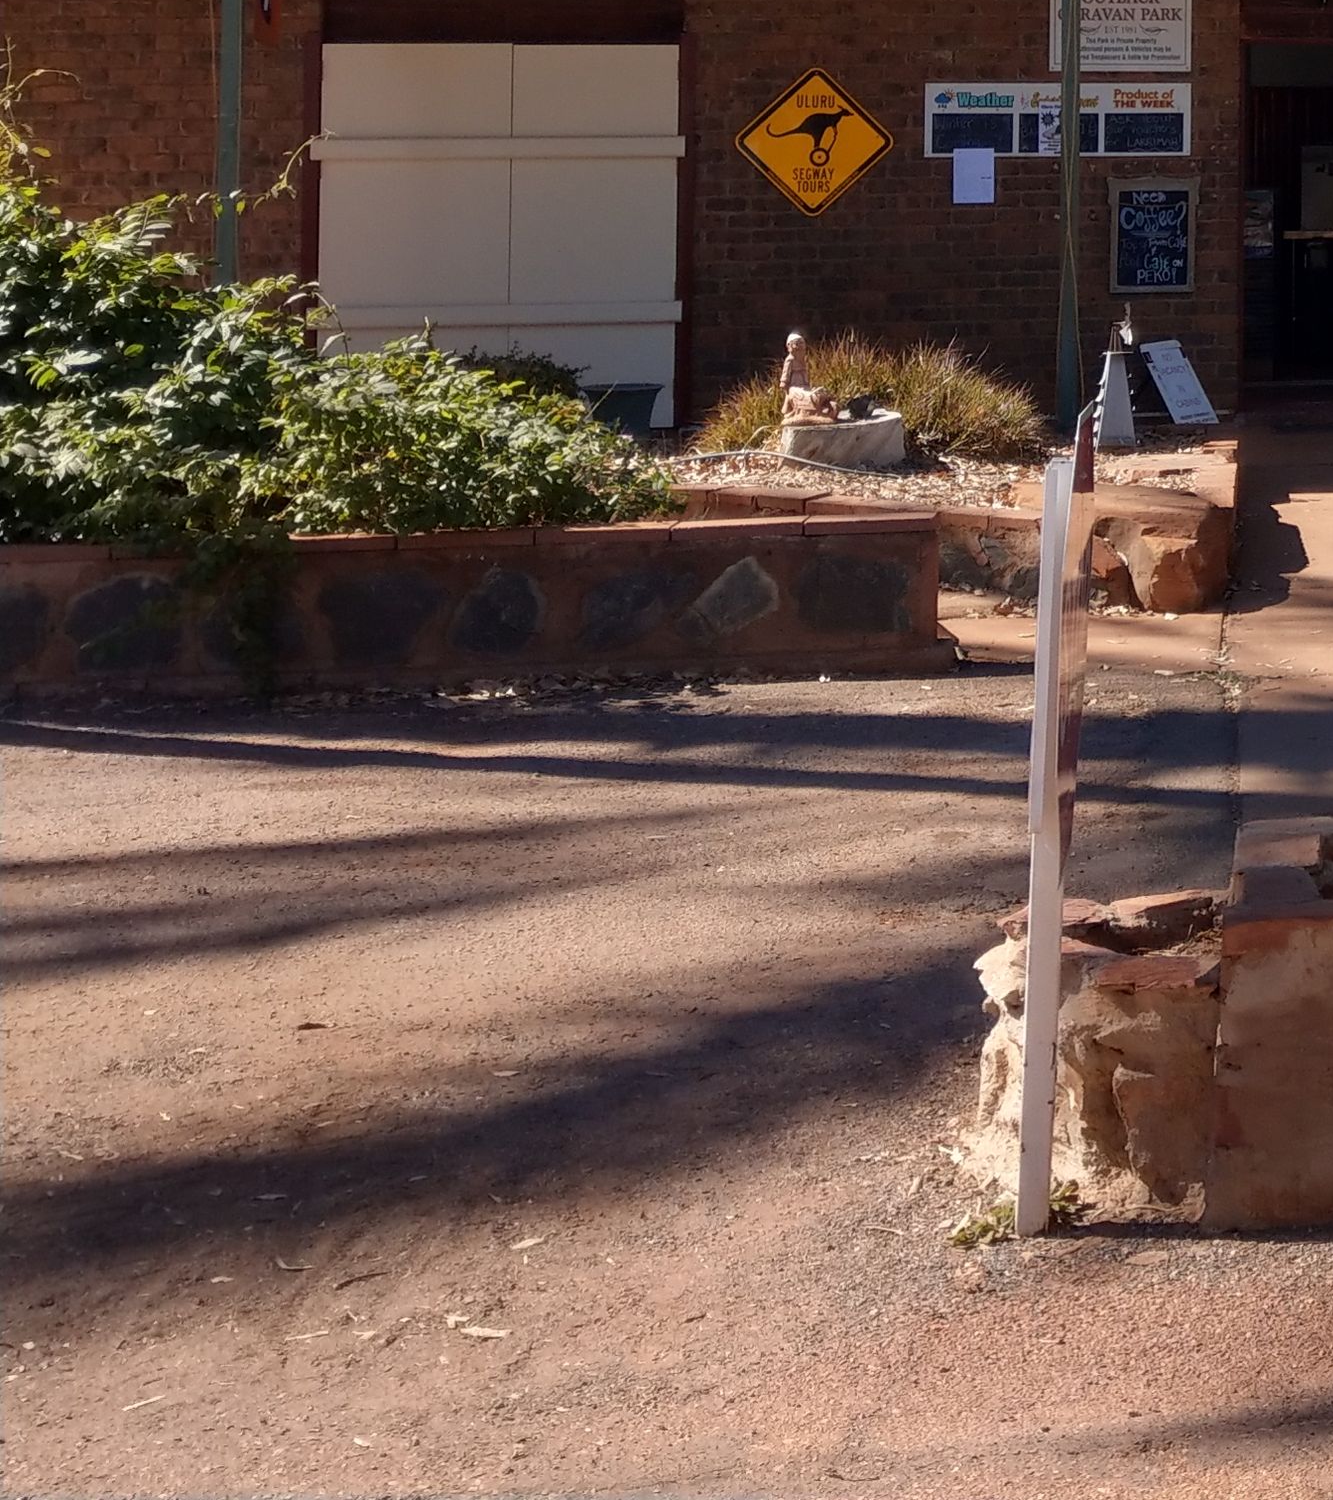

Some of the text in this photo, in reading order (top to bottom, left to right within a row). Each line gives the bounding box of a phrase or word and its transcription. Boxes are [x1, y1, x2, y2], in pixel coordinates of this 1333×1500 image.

[1058, 8, 1183, 21] RAVAN PARK
[1104, 26, 1119, 34] EST
[957, 91, 1014, 108] Weather
[1114, 89, 1174, 99] Product of
[796, 95, 835, 108] ULURU
[1113, 100, 1174, 108] THE WEEK
[792, 168, 834, 180] SEGWAY
[797, 181, 830, 193] TOURS
[1120, 202, 1187, 234] Coffee?
[1137, 268, 1177, 284] PEKO!
